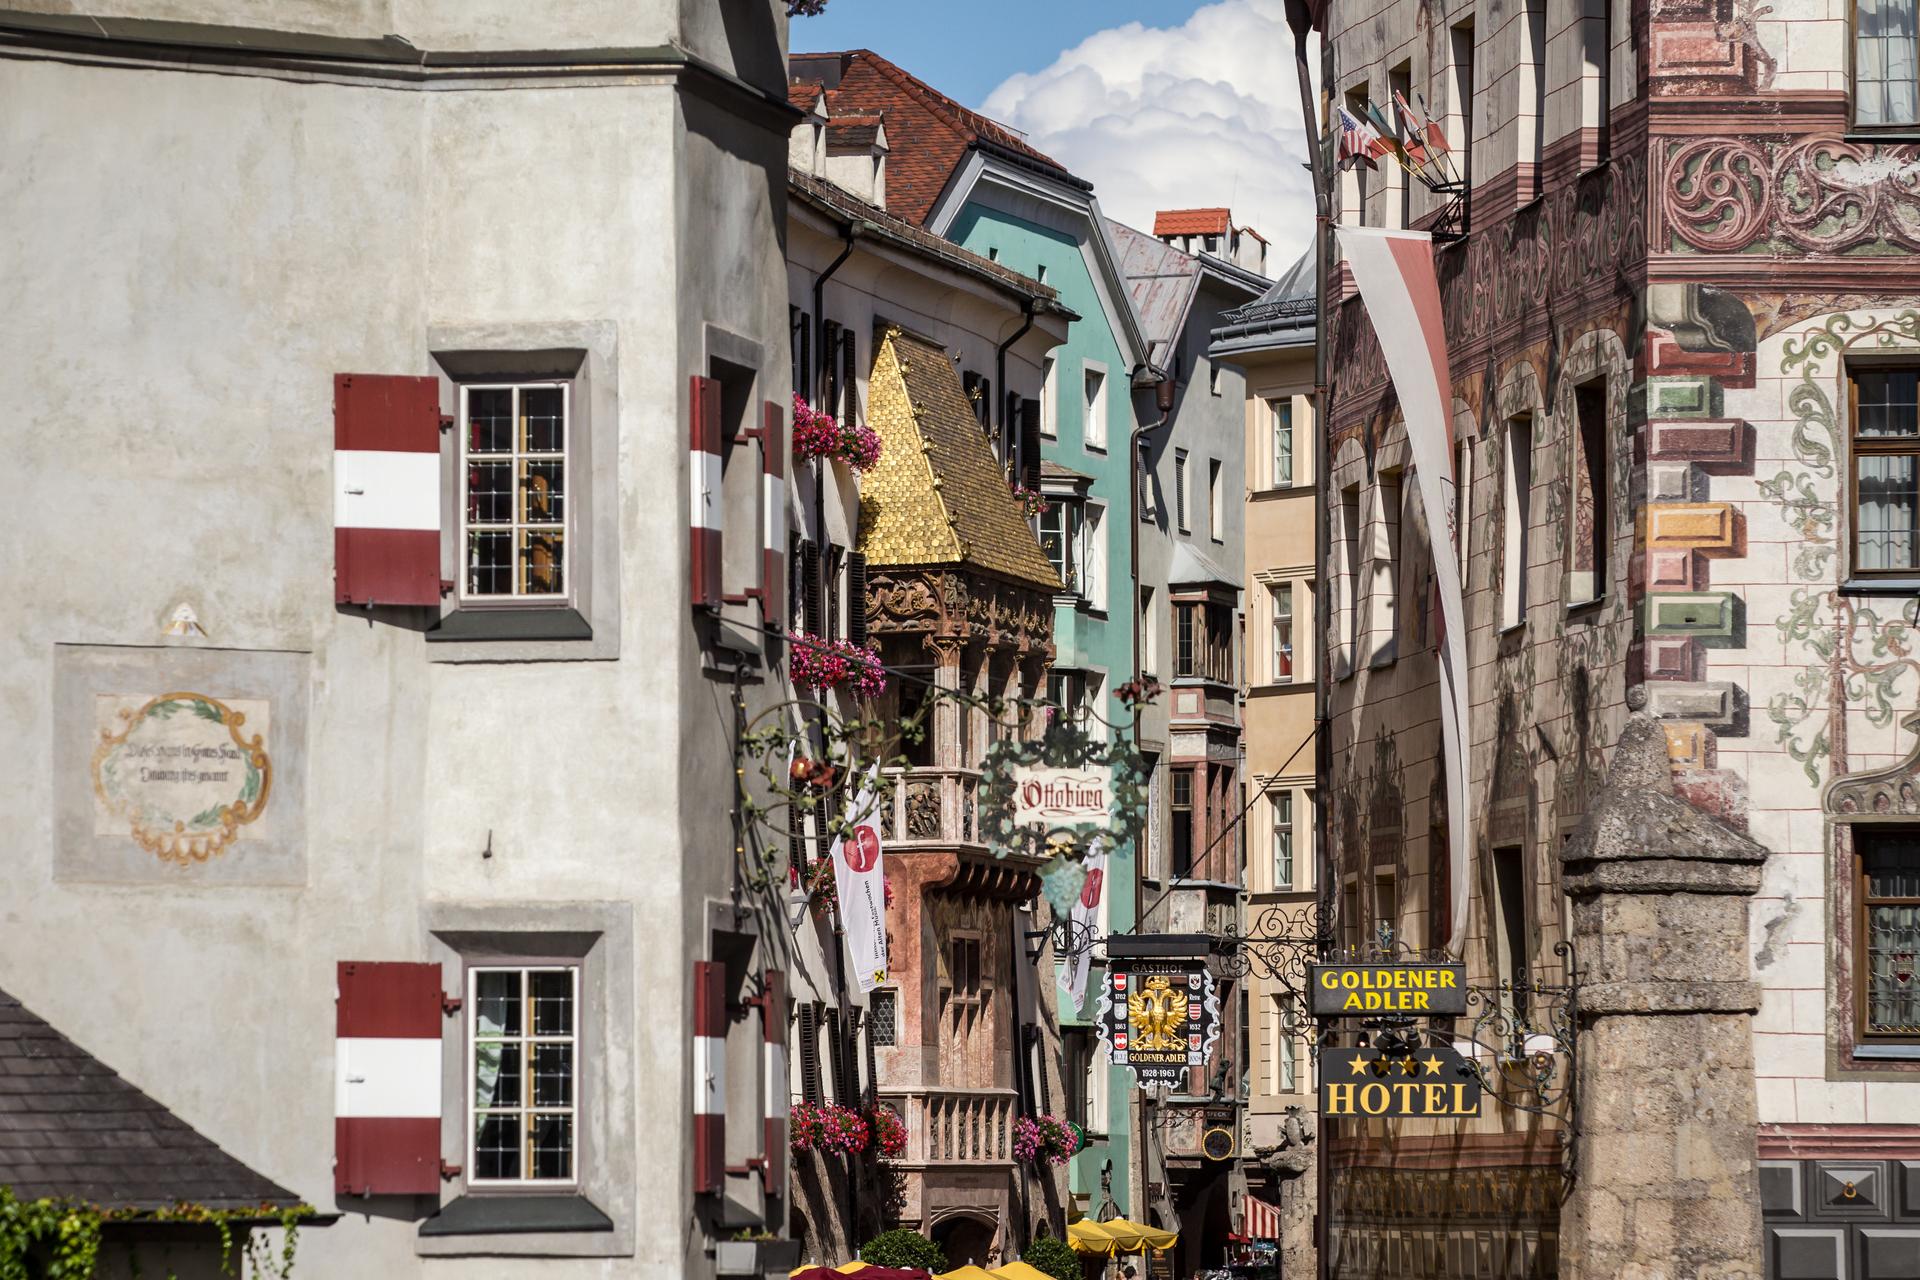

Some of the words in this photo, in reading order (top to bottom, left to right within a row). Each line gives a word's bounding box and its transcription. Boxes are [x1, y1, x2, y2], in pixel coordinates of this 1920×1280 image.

[1021, 779, 1104, 811] Ottoburg
[1131, 963, 1183, 973] GASTHOF
[1321, 970, 1457, 989] GOLDENER
[1343, 991, 1430, 1010] ADLER
[1129, 1053, 1164, 1063] GOLDENER
[1165, 1053, 1187, 1063] ADLER
[1325, 1082, 1478, 1115] HOTEL
